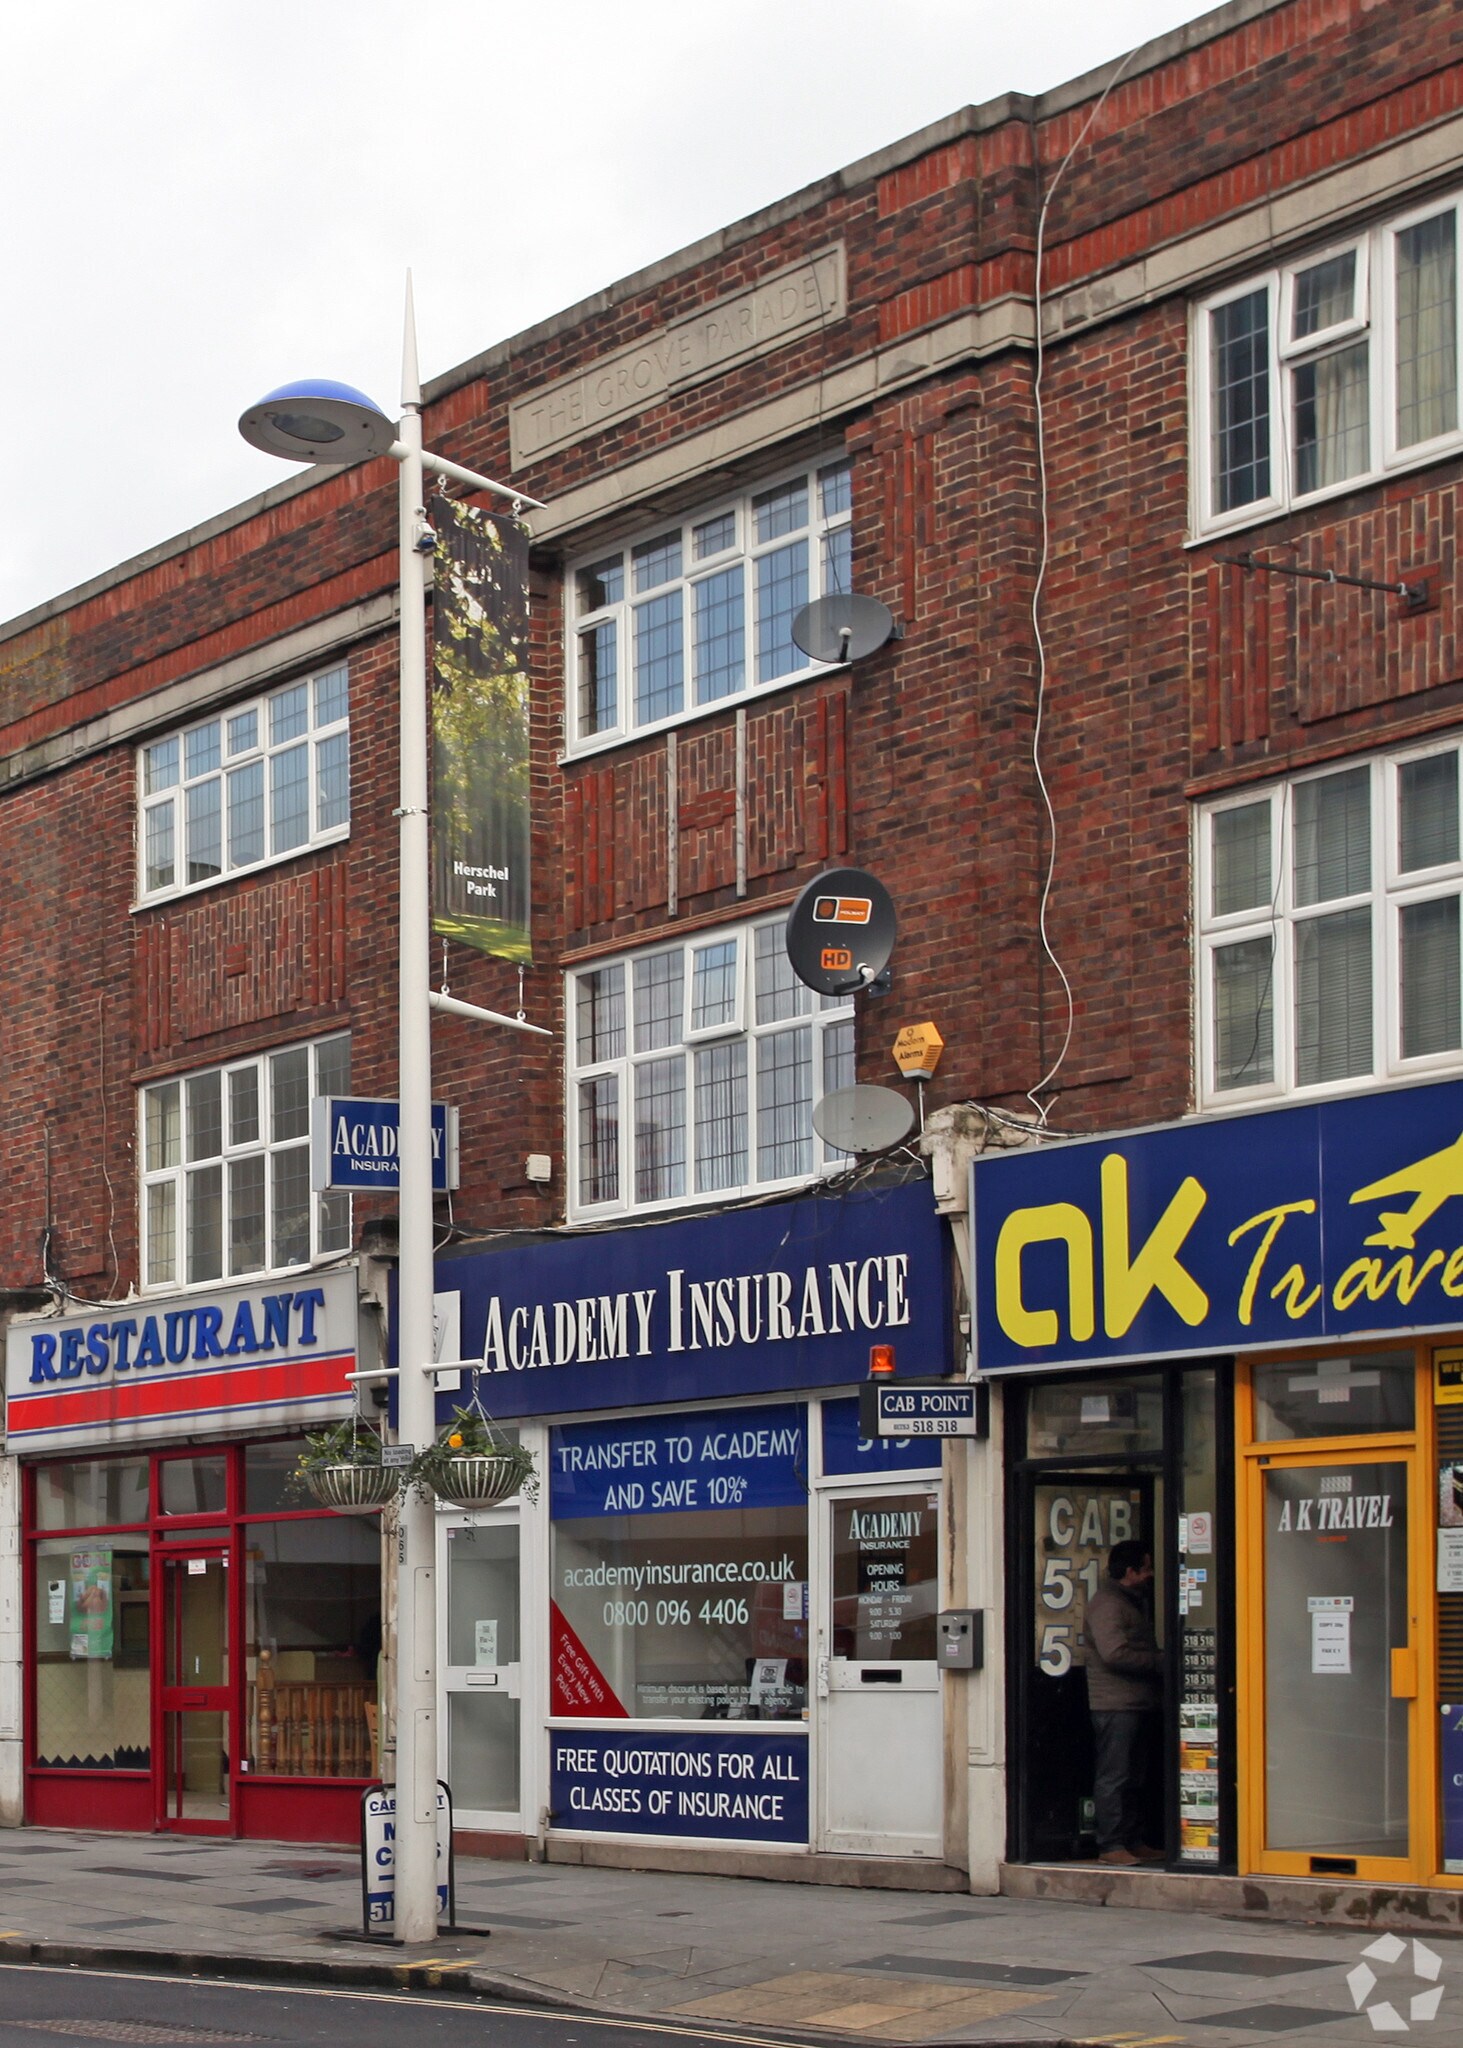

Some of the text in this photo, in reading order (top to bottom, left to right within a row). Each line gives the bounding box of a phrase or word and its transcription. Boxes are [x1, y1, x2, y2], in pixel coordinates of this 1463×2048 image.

[531, 275, 818, 440] THE GROVE PARADE
[453, 861, 509, 880] Herschel
[466, 881, 497, 898] Park
[824, 952, 848, 966] HD
[899, 1050, 924, 1060] Alarms
[333, 1116, 443, 1159] ACADY
[481, 1290, 656, 1373] ACADEMY
[667, 1254, 910, 1352] INSURANCE
[29, 1288, 325, 1383] RESTAURANT
[884, 1395, 970, 1412] CAB POINT
[913, 1421, 933, 1432] 518
[937, 1421, 957, 1432] 518
[558, 1428, 800, 1472] TRANSFER TO ACADEMY
[604, 1482, 645, 1511] AND
[651, 1479, 697, 1508] SAVE
[1050, 1498, 1133, 1546] CAB
[1278, 1495, 1394, 1532] A K TRAVEL
[848, 1509, 922, 1539] ACADEMY
[860, 1540, 910, 1550] INSURANCE
[564, 1553, 795, 1591] academyinsurance.co.uk
[867, 1563, 904, 1576] OPENING
[870, 1580, 900, 1592] HOURS
[858, 1596, 883, 1604] MONDAY
[892, 1595, 913, 1603] FRIDAY
[603, 1598, 749, 1626] 0800 096 4406
[870, 1620, 900, 1628] SATURDAY
[1184, 1636, 1215, 1646] 518 518
[560, 1634, 604, 1703] Free Gift With
[1184, 1655, 1215, 1665] 518 518
[558, 1653, 591, 1704] Every New
[1184, 1674, 1215, 1685] 518 518
[637, 1684, 666, 1693] Minimum
[668, 1685, 696, 1694] discount
[699, 1685, 704, 1693] is
[706, 1684, 728, 1694] based
[729, 1686, 739, 1694] on
[795, 1686, 803, 1694] to
[643, 1695, 668, 1704] transfer
[670, 1696, 686, 1706] your
[688, 1695, 715, 1706] existing
[556, 1748, 799, 1781] FREE QUOTATIONS FOR ALL
[570, 1786, 784, 1821] CLASSES OF INSURANCE
